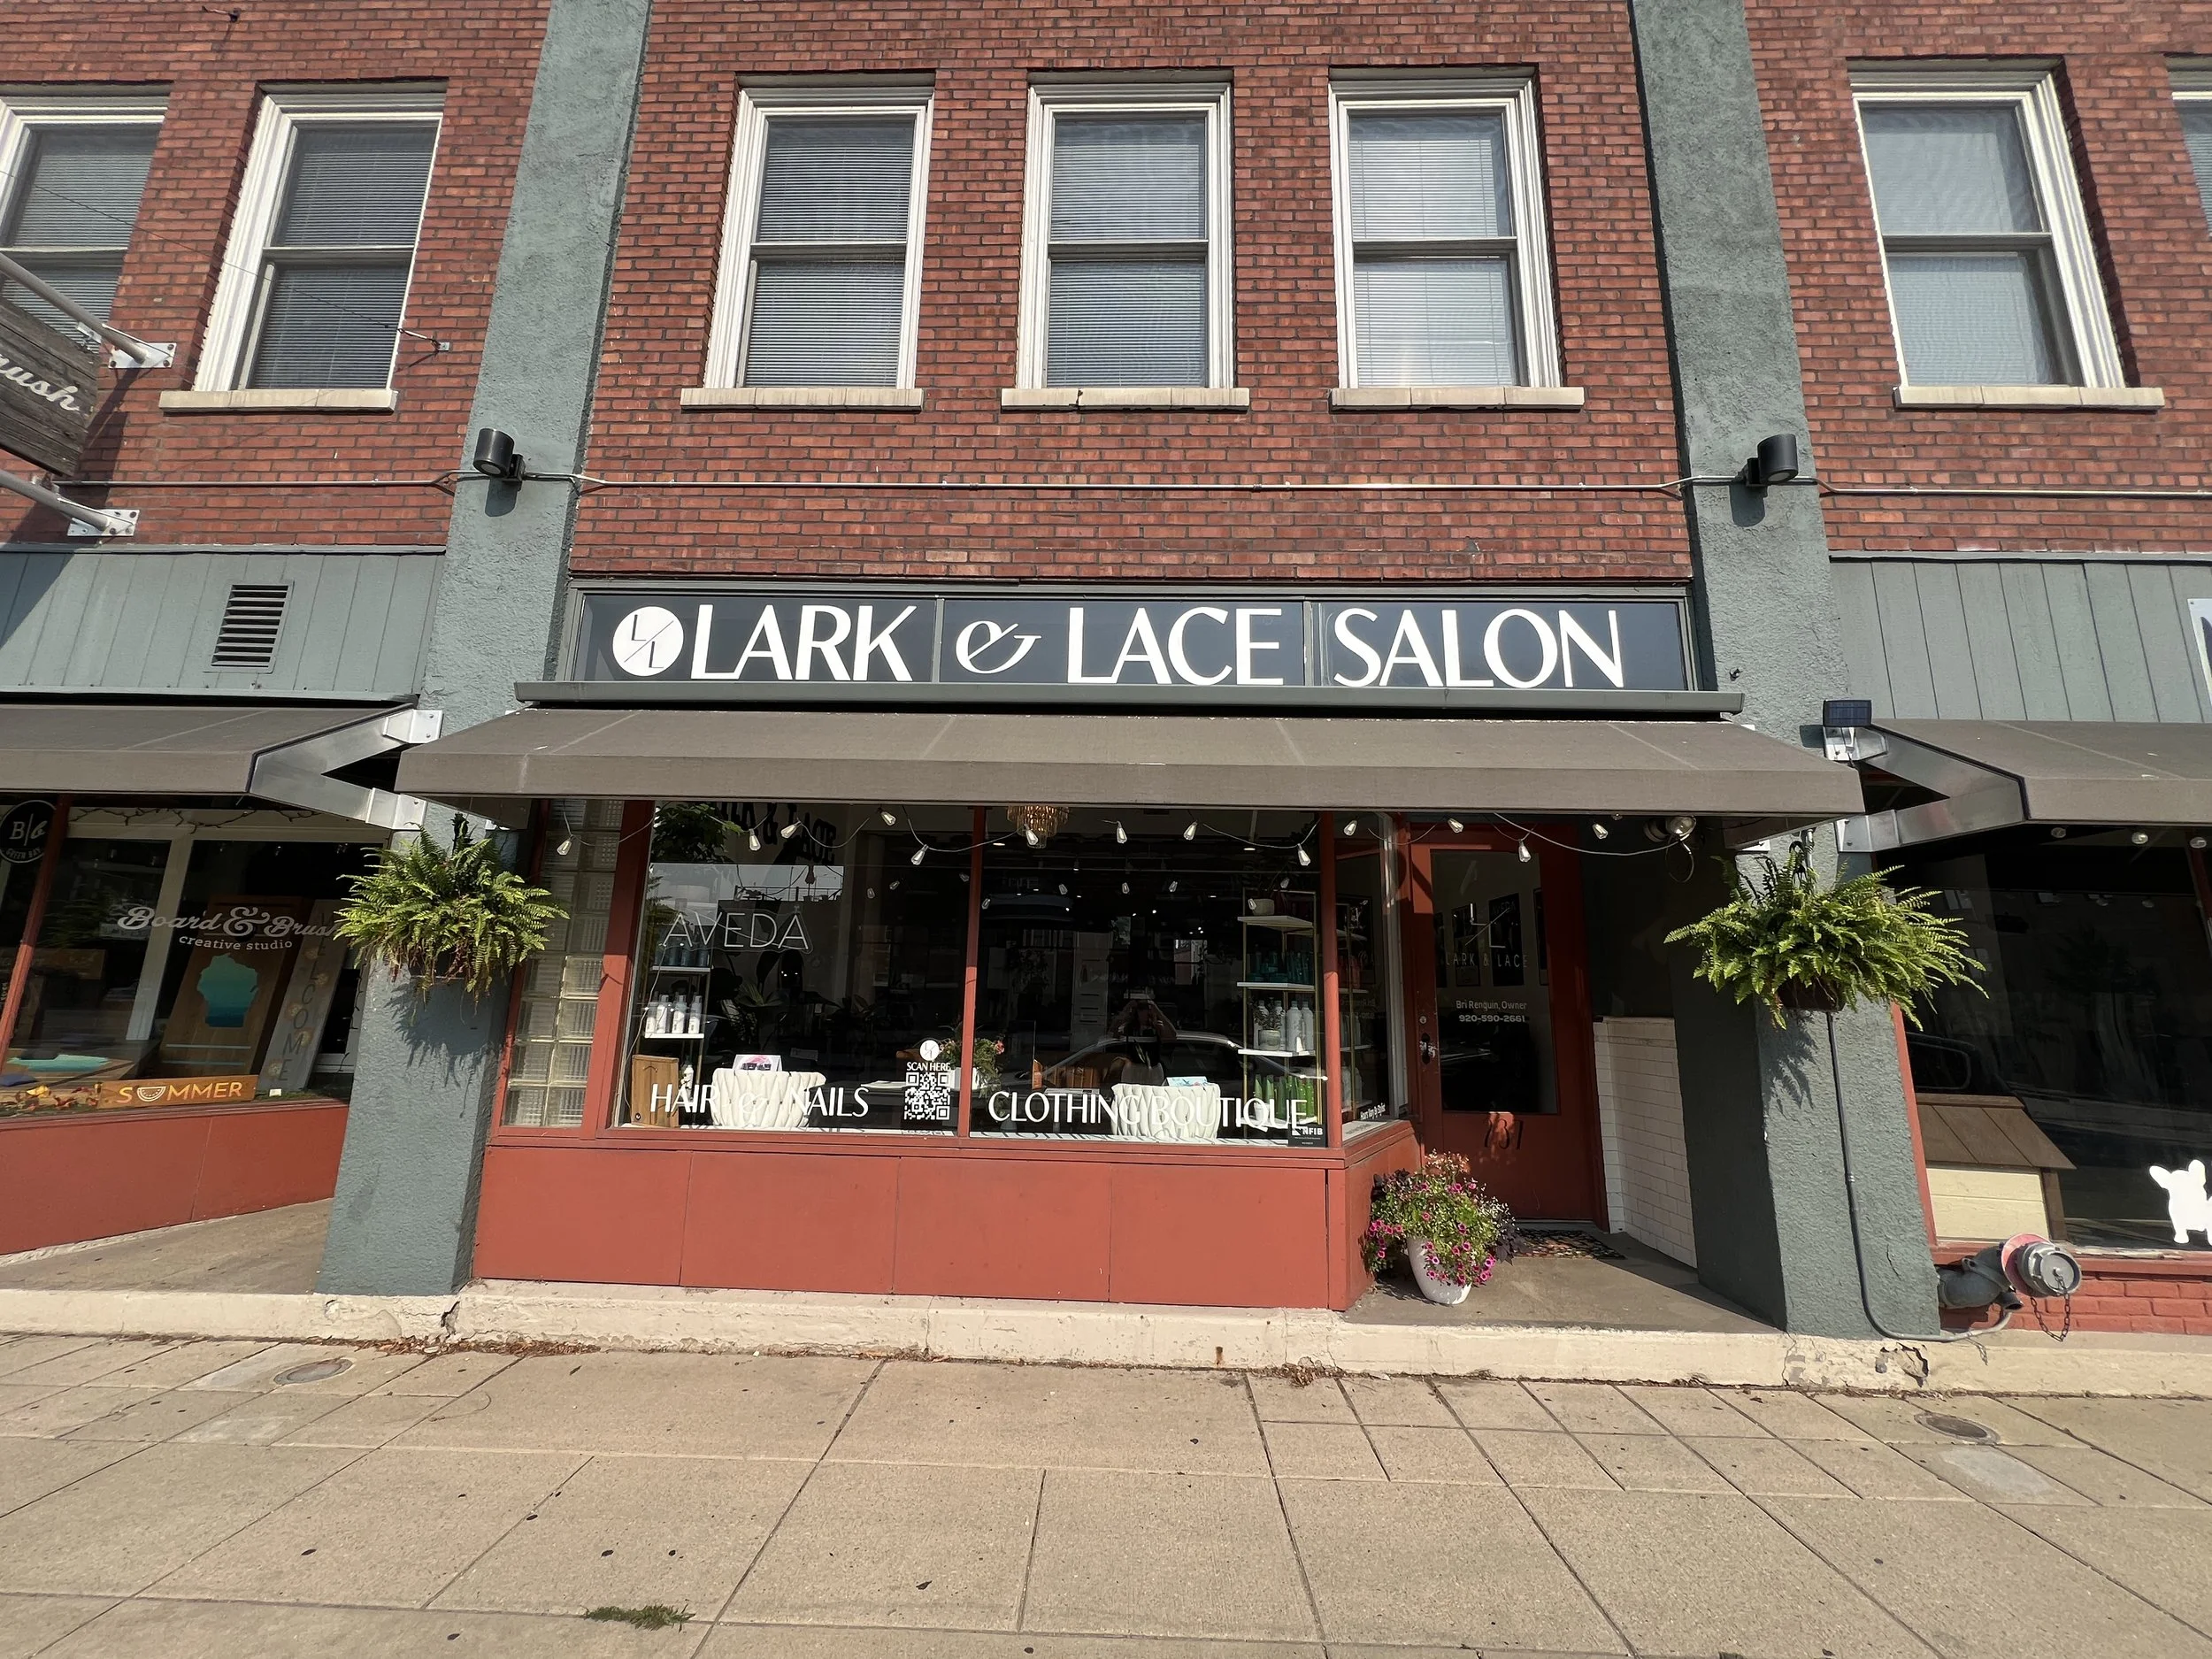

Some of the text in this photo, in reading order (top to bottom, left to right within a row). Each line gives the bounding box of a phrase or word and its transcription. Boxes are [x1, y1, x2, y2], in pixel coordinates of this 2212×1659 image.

[690, 604, 917, 682] LARK
[954, 619, 1042, 675] &
[1067, 605, 1284, 687] LACE
[1333, 607, 1624, 688] SALON
[117, 906, 223, 931] Board
[223, 906, 271, 937] &
[662, 912, 809, 950] AVEDA
[179, 935, 293, 950] creative studio
[1446, 952, 1529, 968] LARK & LACE
[1455, 999, 1468, 1010] Bri
[1501, 1000, 1527, 1010] Owner
[906, 1062, 951, 1071] SCAN HERE
[650, 1083, 718, 1114] HAIR
[787, 1086, 870, 1118] NAILS
[987, 1090, 1308, 1133] CLOTHING BOUTIQUE
[1302, 1127, 1324, 1136] NFIB
